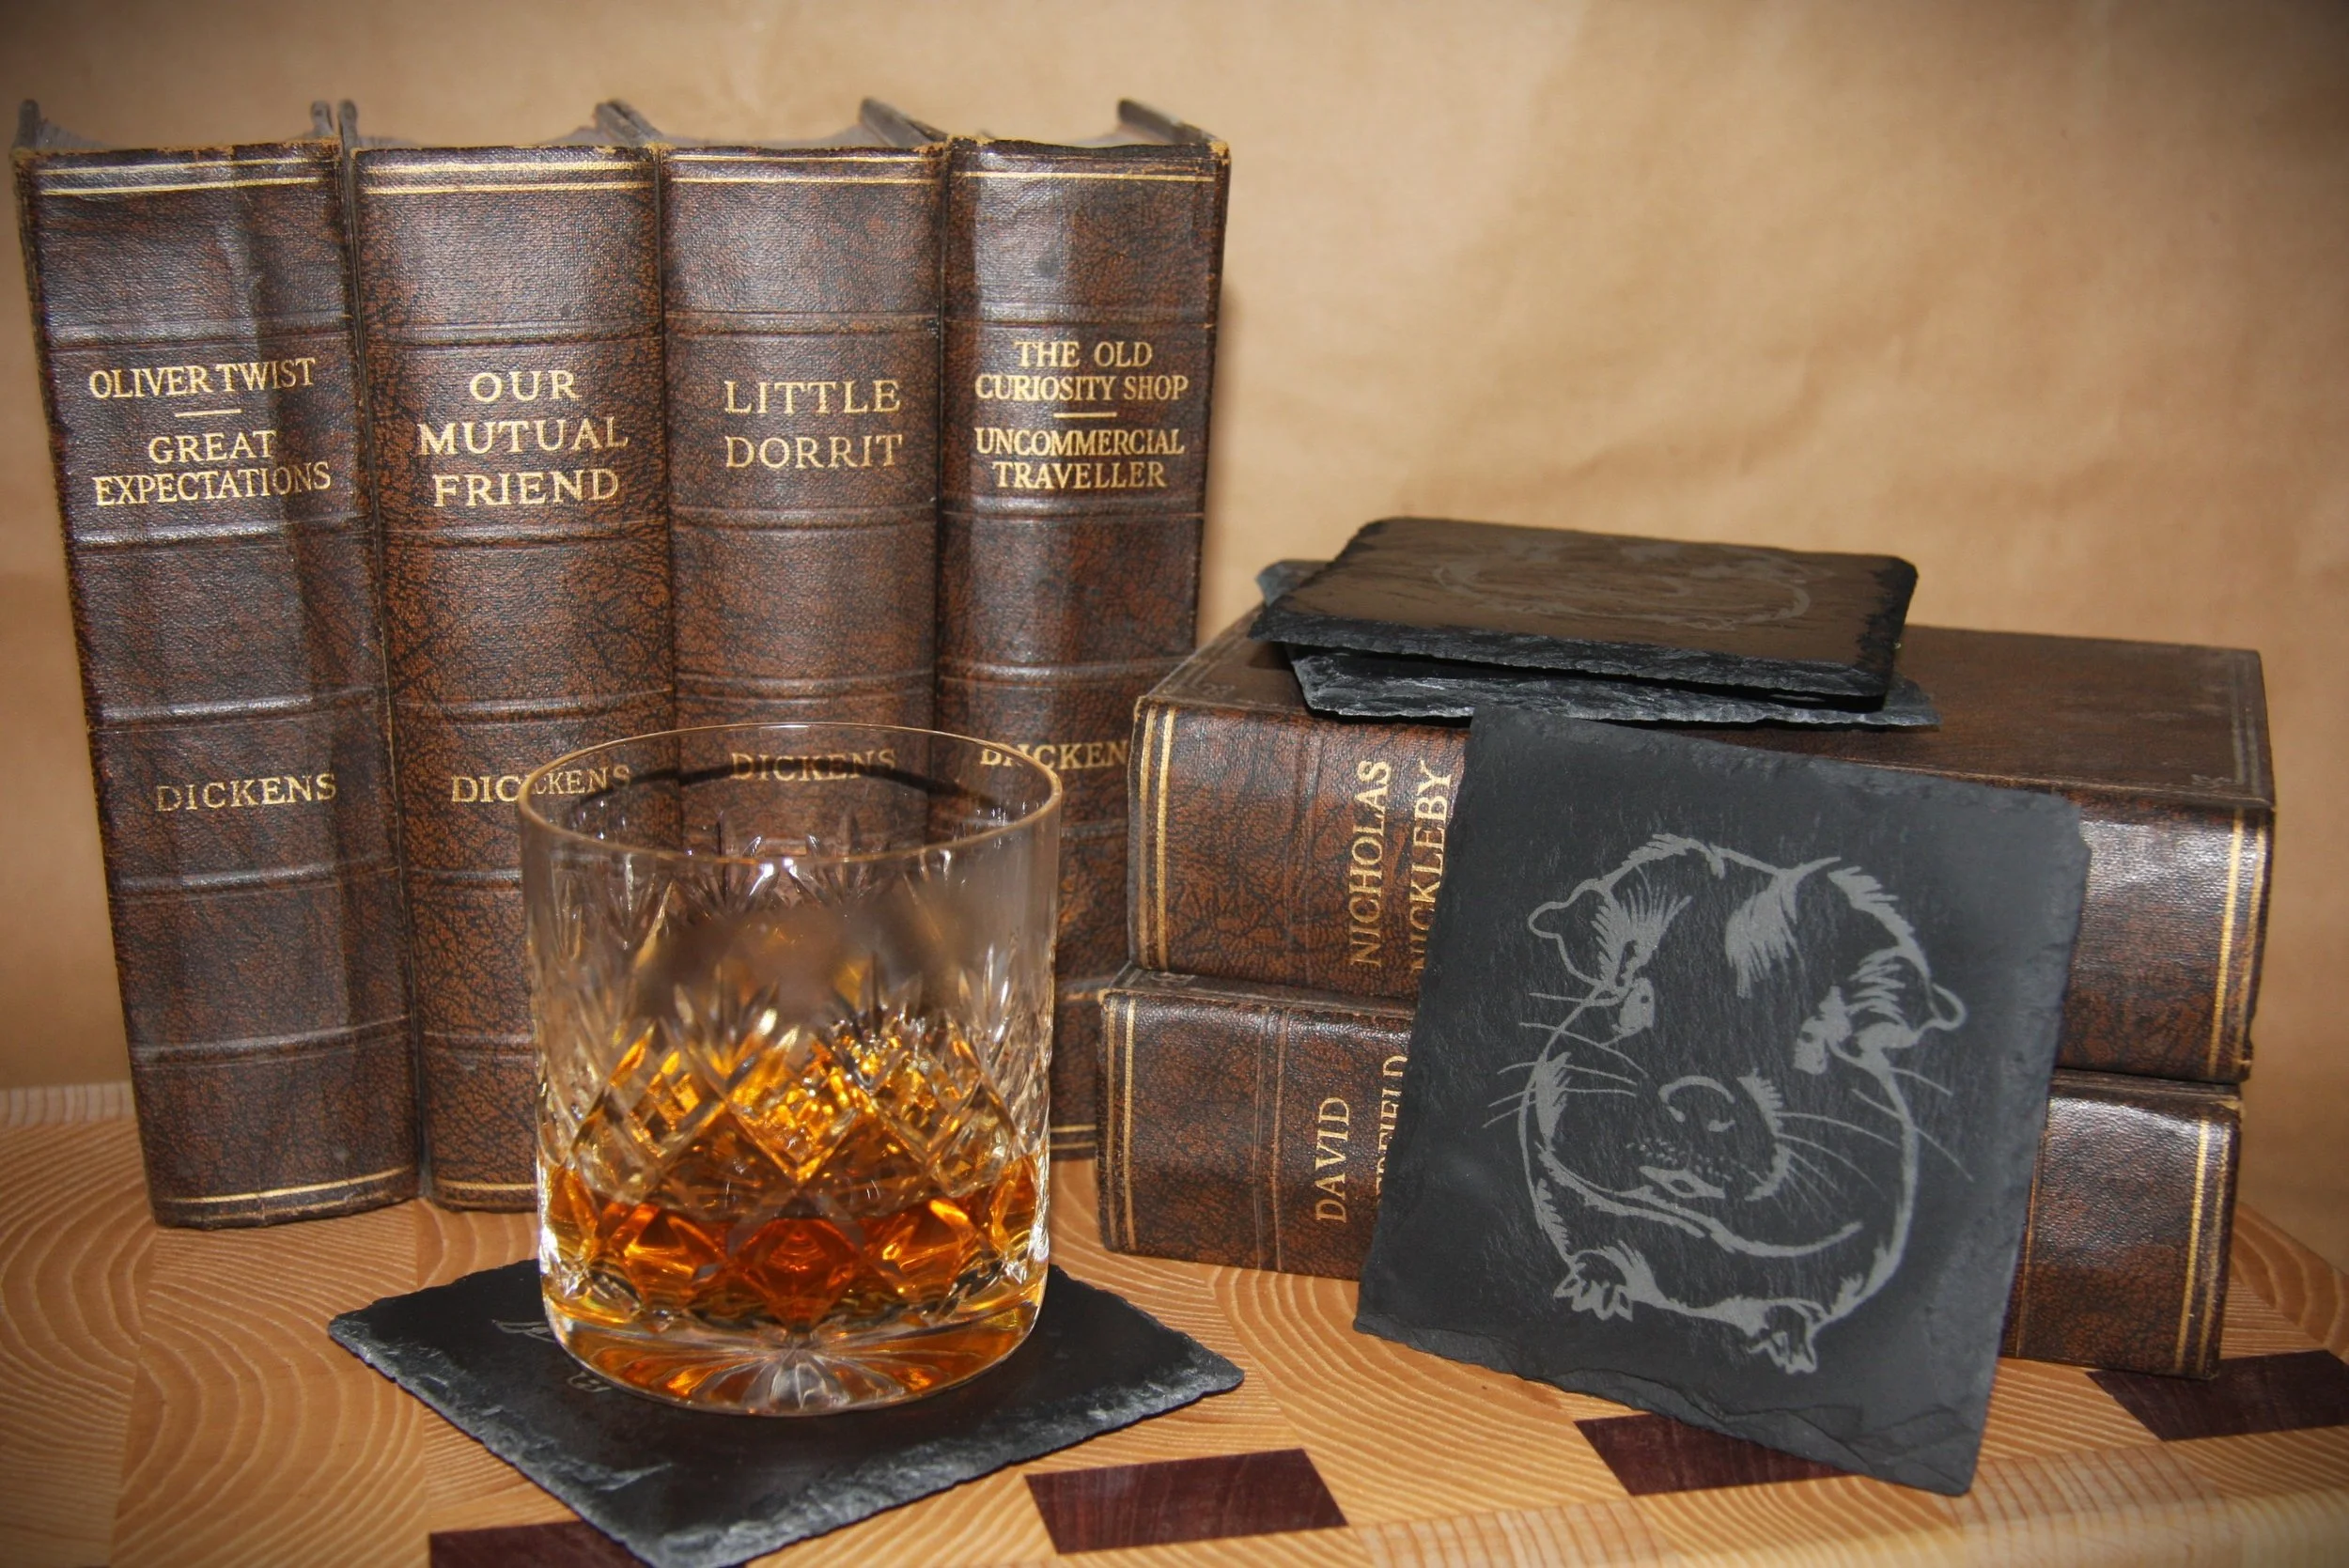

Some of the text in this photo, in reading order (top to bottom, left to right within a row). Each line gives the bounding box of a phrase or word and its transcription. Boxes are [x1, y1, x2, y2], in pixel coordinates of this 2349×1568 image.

[1014, 340, 1153, 368] THE OLD
[89, 357, 317, 399] OLIVER TWIST
[470, 368, 583, 403] OUR
[974, 374, 1190, 402] CURIOSITY SHOP
[723, 380, 901, 414] LITTLE
[148, 428, 277, 464] GREAT
[418, 415, 630, 456] MUTUAL
[723, 433, 904, 470] DORRIT
[974, 427, 1186, 458] UNCOMMERCIAL
[92, 461, 332, 507] EXPECTATIONS
[433, 467, 620, 508] FRIEND
[992, 460, 1167, 489] TRAVELLER
[730, 748, 897, 783] DICKENS
[980, 739, 1128, 771] DICKEN
[156, 772, 337, 813] DICKENS
[451, 763, 631, 803] DICKENS
[1348, 760, 1392, 969] NICHOLAS
[1315, 1096, 1350, 1223] DAVID
